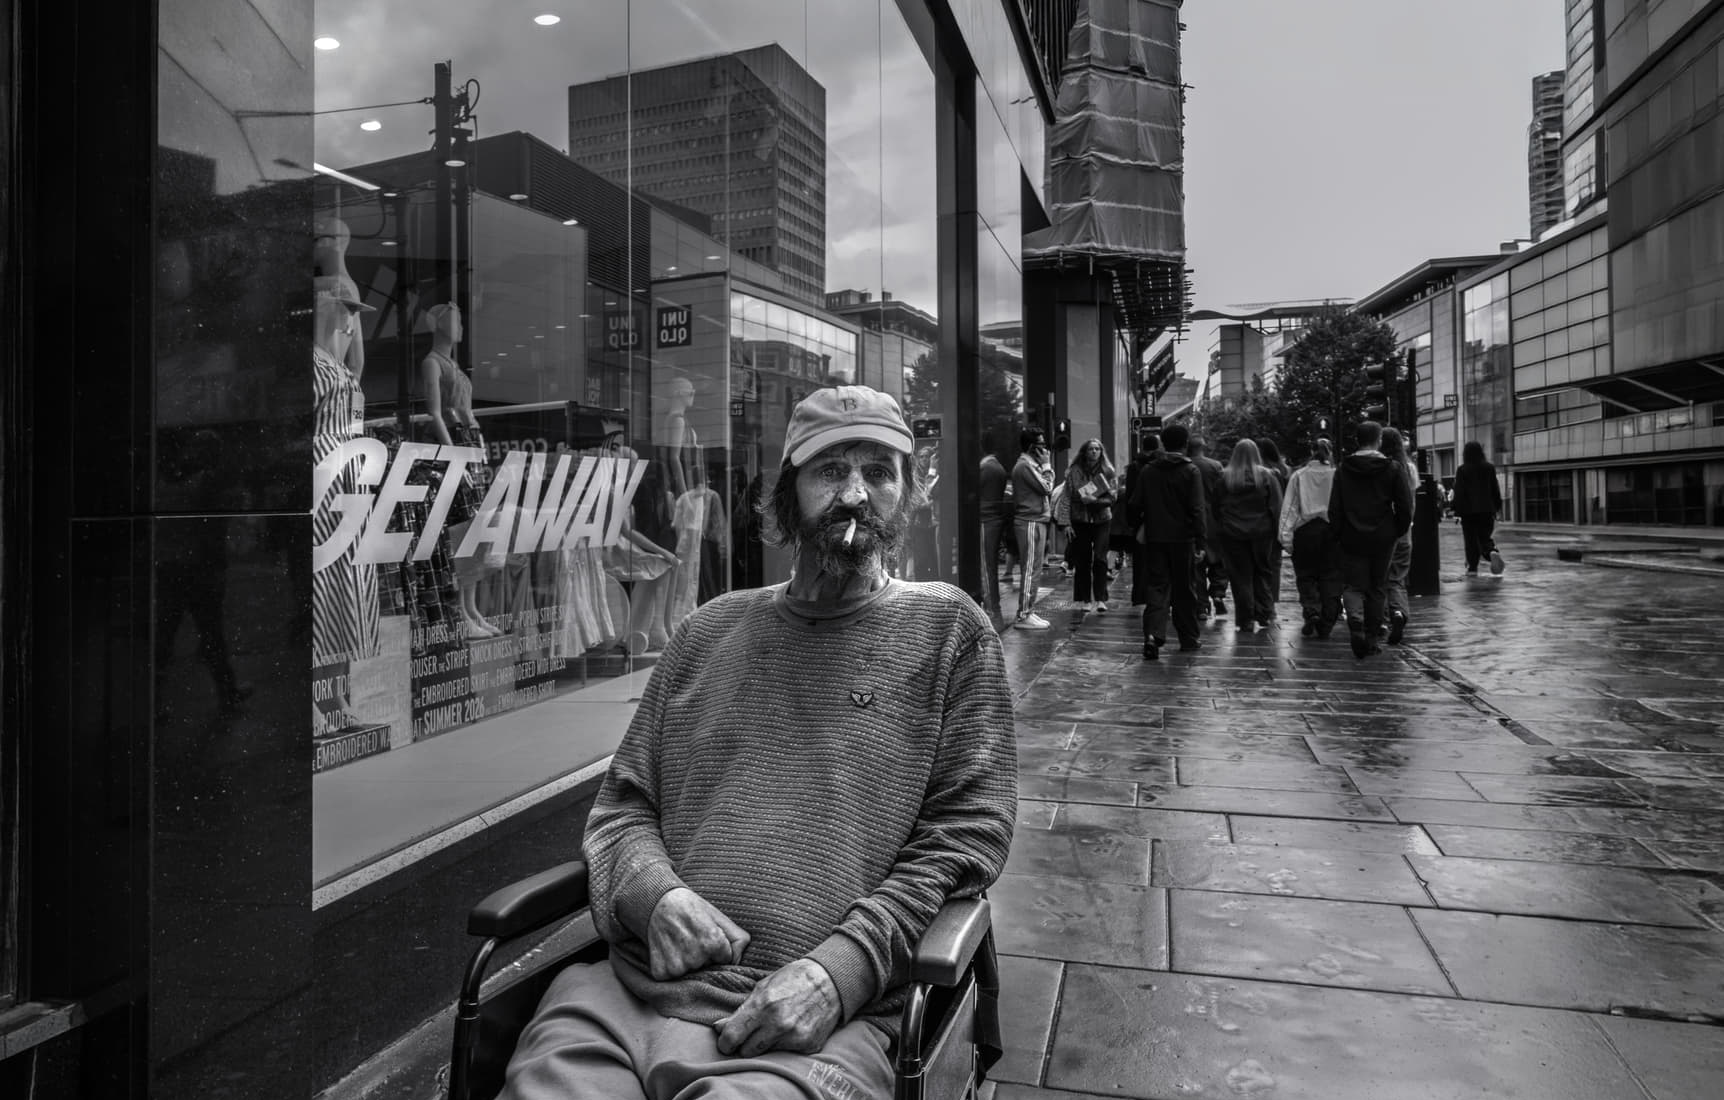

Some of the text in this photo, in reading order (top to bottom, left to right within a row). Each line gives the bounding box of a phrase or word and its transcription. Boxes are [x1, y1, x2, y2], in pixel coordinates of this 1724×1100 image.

[313, 437, 650, 573] GET AWAY
[426, 623, 449, 647] DRESS
[446, 648, 469, 671] STRIPE
[421, 676, 470, 708] EMBROIDERED
[424, 702, 463, 735] SUMMER
[464, 695, 485, 722] 2026
[316, 731, 378, 770] EMBROIDERED
